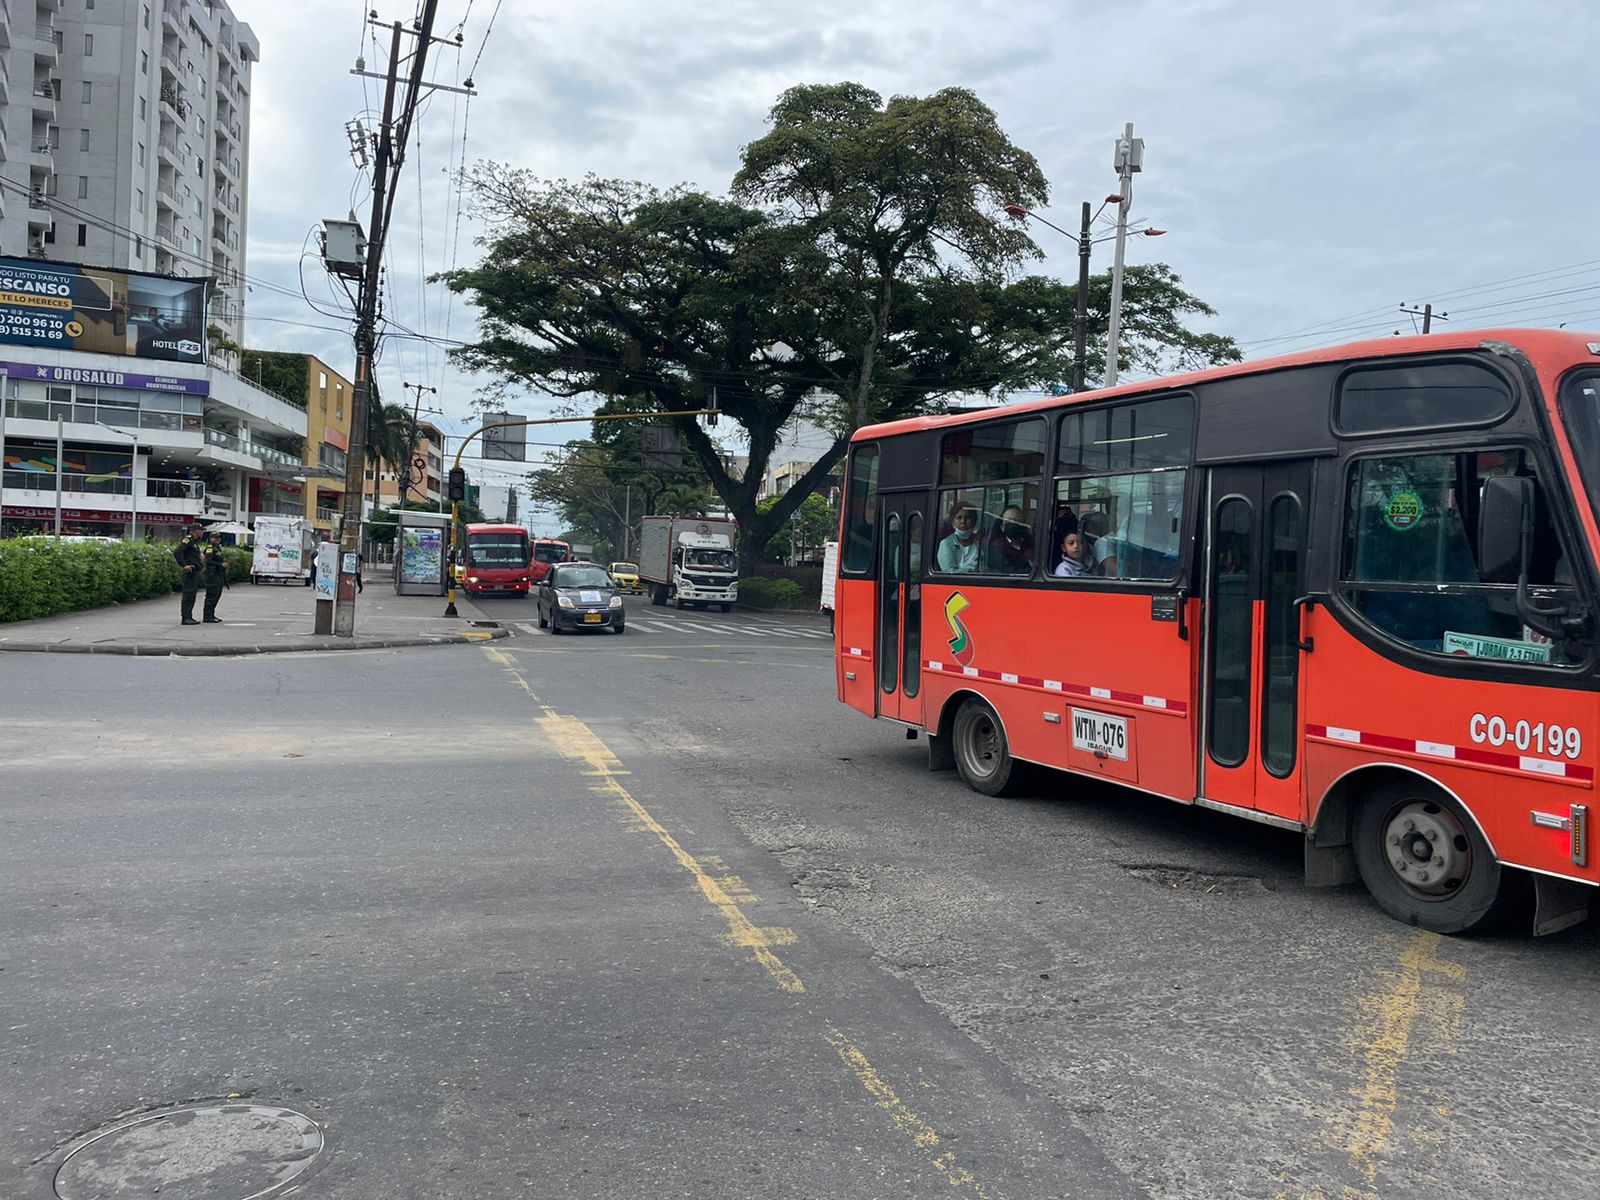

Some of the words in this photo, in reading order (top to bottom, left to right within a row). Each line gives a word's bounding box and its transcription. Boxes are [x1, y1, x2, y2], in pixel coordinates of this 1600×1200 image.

[0, 278, 70, 296] SCANSO
[2, 294, 13, 302] TE
[28, 297, 69, 308] MERECES
[7, 315, 31, 326] 200
[33, 318, 48, 328] 96
[49, 320, 63, 329] 10
[12, 326, 31, 336] 515
[33, 329, 46, 338] 31
[48, 331, 63, 340] 69
[152, 340, 177, 350] HOTEL
[54, 368, 124, 385] OROSALUD
[1074, 716, 1124, 748] WTM-076
[1470, 712, 1581, 759] CO-0199
